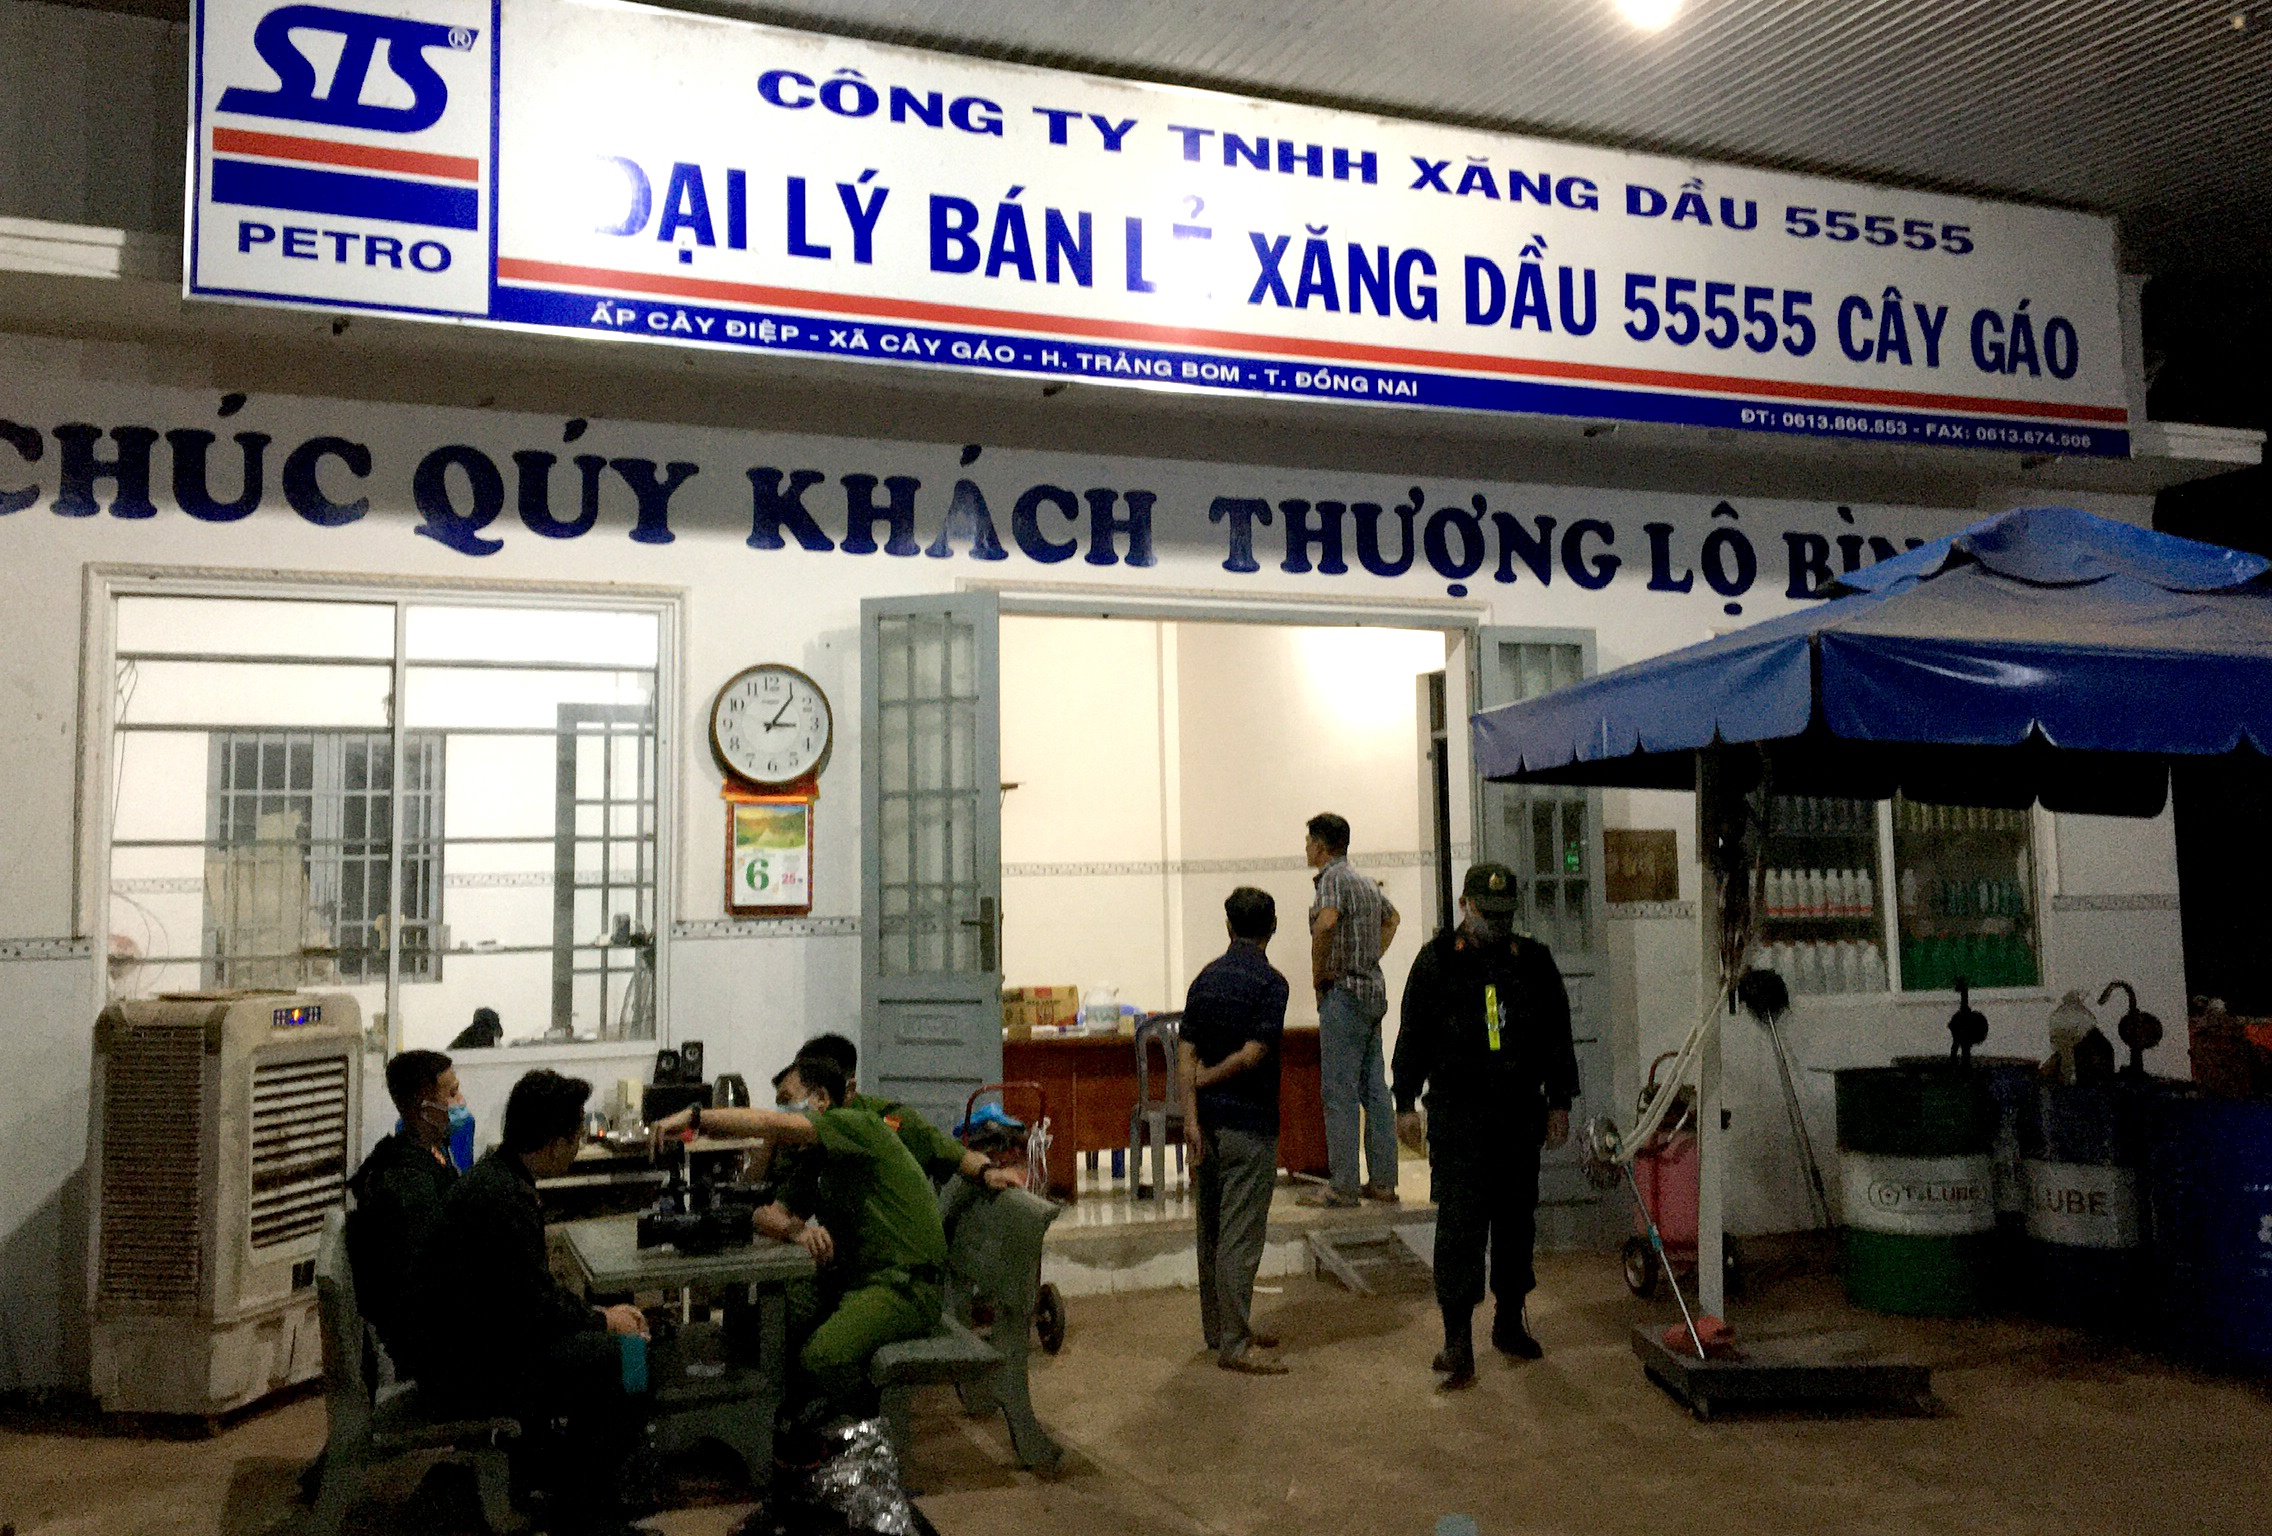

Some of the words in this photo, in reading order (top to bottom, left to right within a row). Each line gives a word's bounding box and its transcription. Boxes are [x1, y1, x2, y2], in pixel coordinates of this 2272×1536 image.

[757, 67, 1004, 138] CÔNG
[1033, 104, 1138, 152] TY
[1168, 123, 1378, 185] TNHH
[1410, 155, 1599, 212] XĂNG
[1626, 175, 1759, 232] DẦU
[1786, 206, 1975, 256] 55555
[237, 220, 453, 274] PETRO
[787, 167, 890, 265] LÝ
[929, 185, 1093, 288] BÁN
[1248, 223, 1439, 324] XĂNG
[1464, 233, 1597, 337] DẦU
[1624, 272, 1817, 356] 55555
[1838, 284, 1949, 368] CÂY
[1970, 298, 2080, 381] GÁO
[591, 300, 636, 326] ẤP
[647, 310, 715, 335] CÂY
[725, 318, 800, 344] ĐIỆP
[829, 328, 869, 351] XÃ
[880, 332, 941, 356] CÂY
[951, 340, 1016, 363] GÁO
[1041, 349, 1068, 369] H.
[1181, 361, 1240, 383] BOM
[1264, 368, 1287, 387] T.
[1377, 378, 1418, 397] NAI
[413, 417, 700, 557] QÚY
[745, 443, 1158, 568] KHÁCH
[1208, 486, 1623, 598] THƯỢNG
[1642, 500, 1759, 616] LỘ
[746, 858, 770, 891] 6
